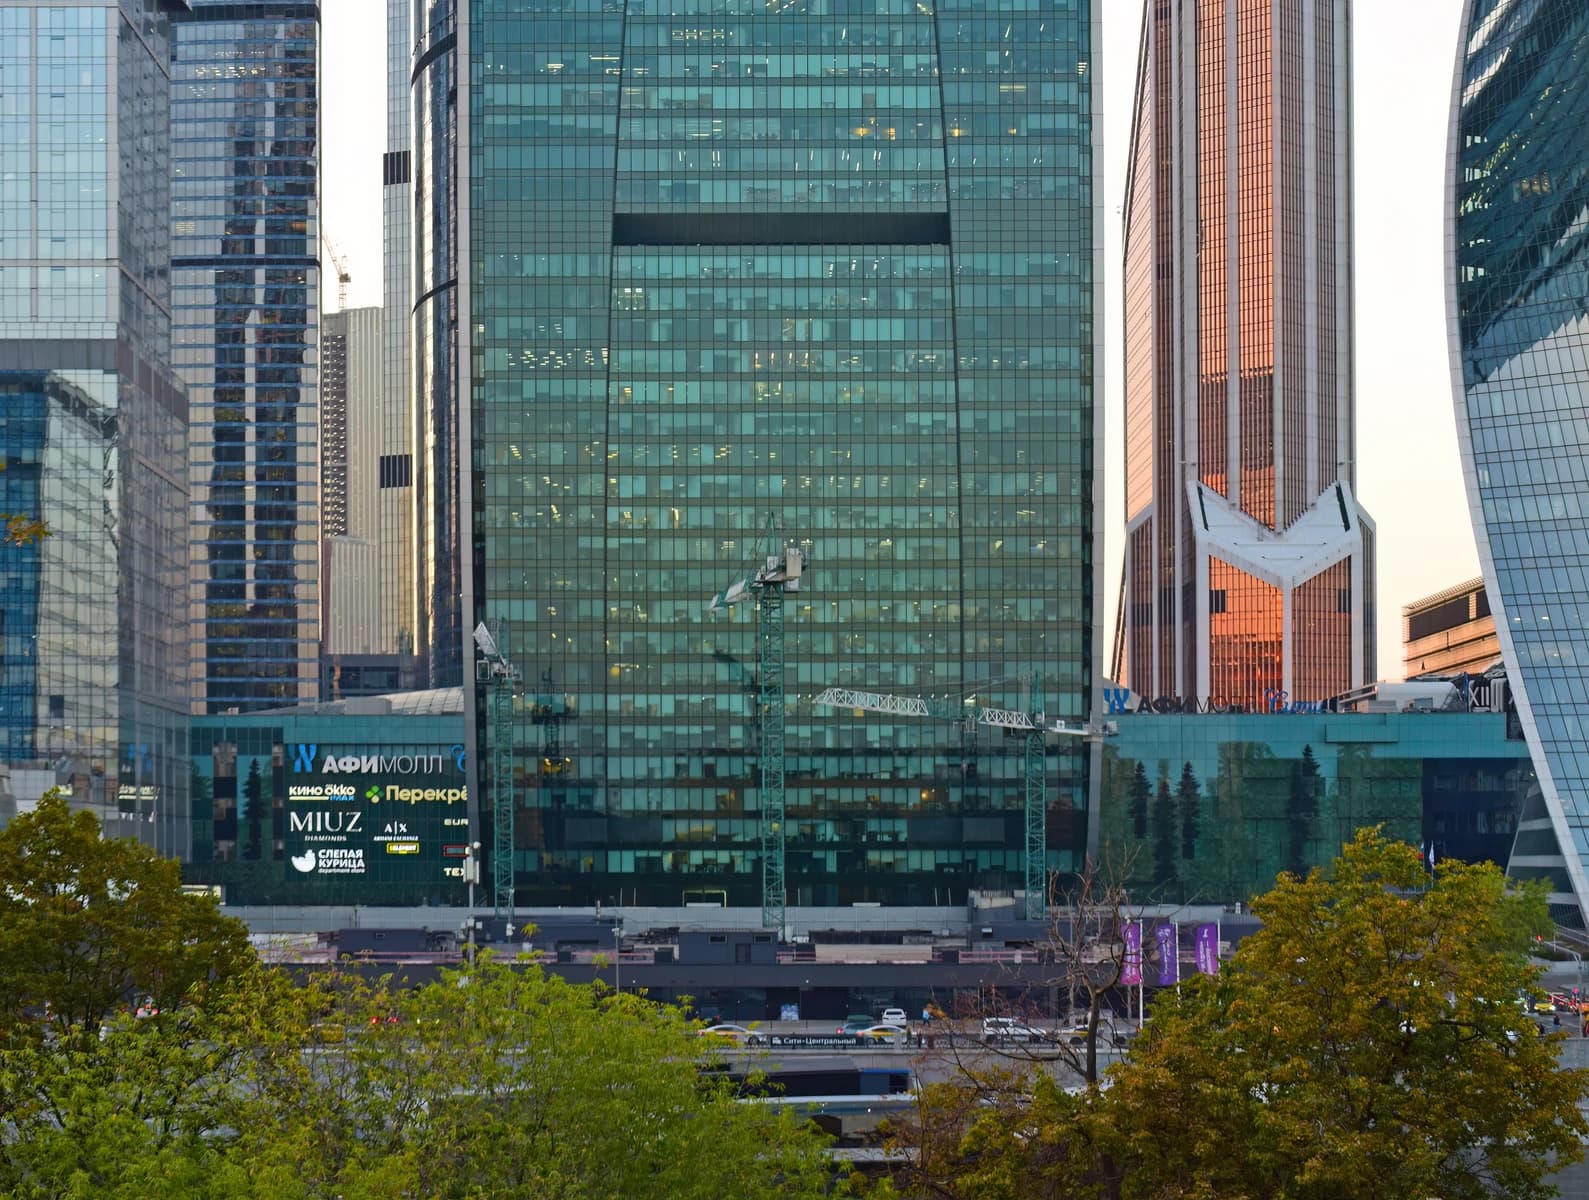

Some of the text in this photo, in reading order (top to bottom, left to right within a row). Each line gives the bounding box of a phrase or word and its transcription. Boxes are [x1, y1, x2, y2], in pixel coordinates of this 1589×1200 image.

[322, 754, 442, 774] АФИМОЛЛ
[289, 786, 323, 796] КИНО
[290, 811, 362, 832] MIUZ
[318, 849, 363, 859] СЛЕПАЯ
[318, 859, 365, 870] КУРИЦА
[783, 1037, 856, 1046] Сити-Центральный
